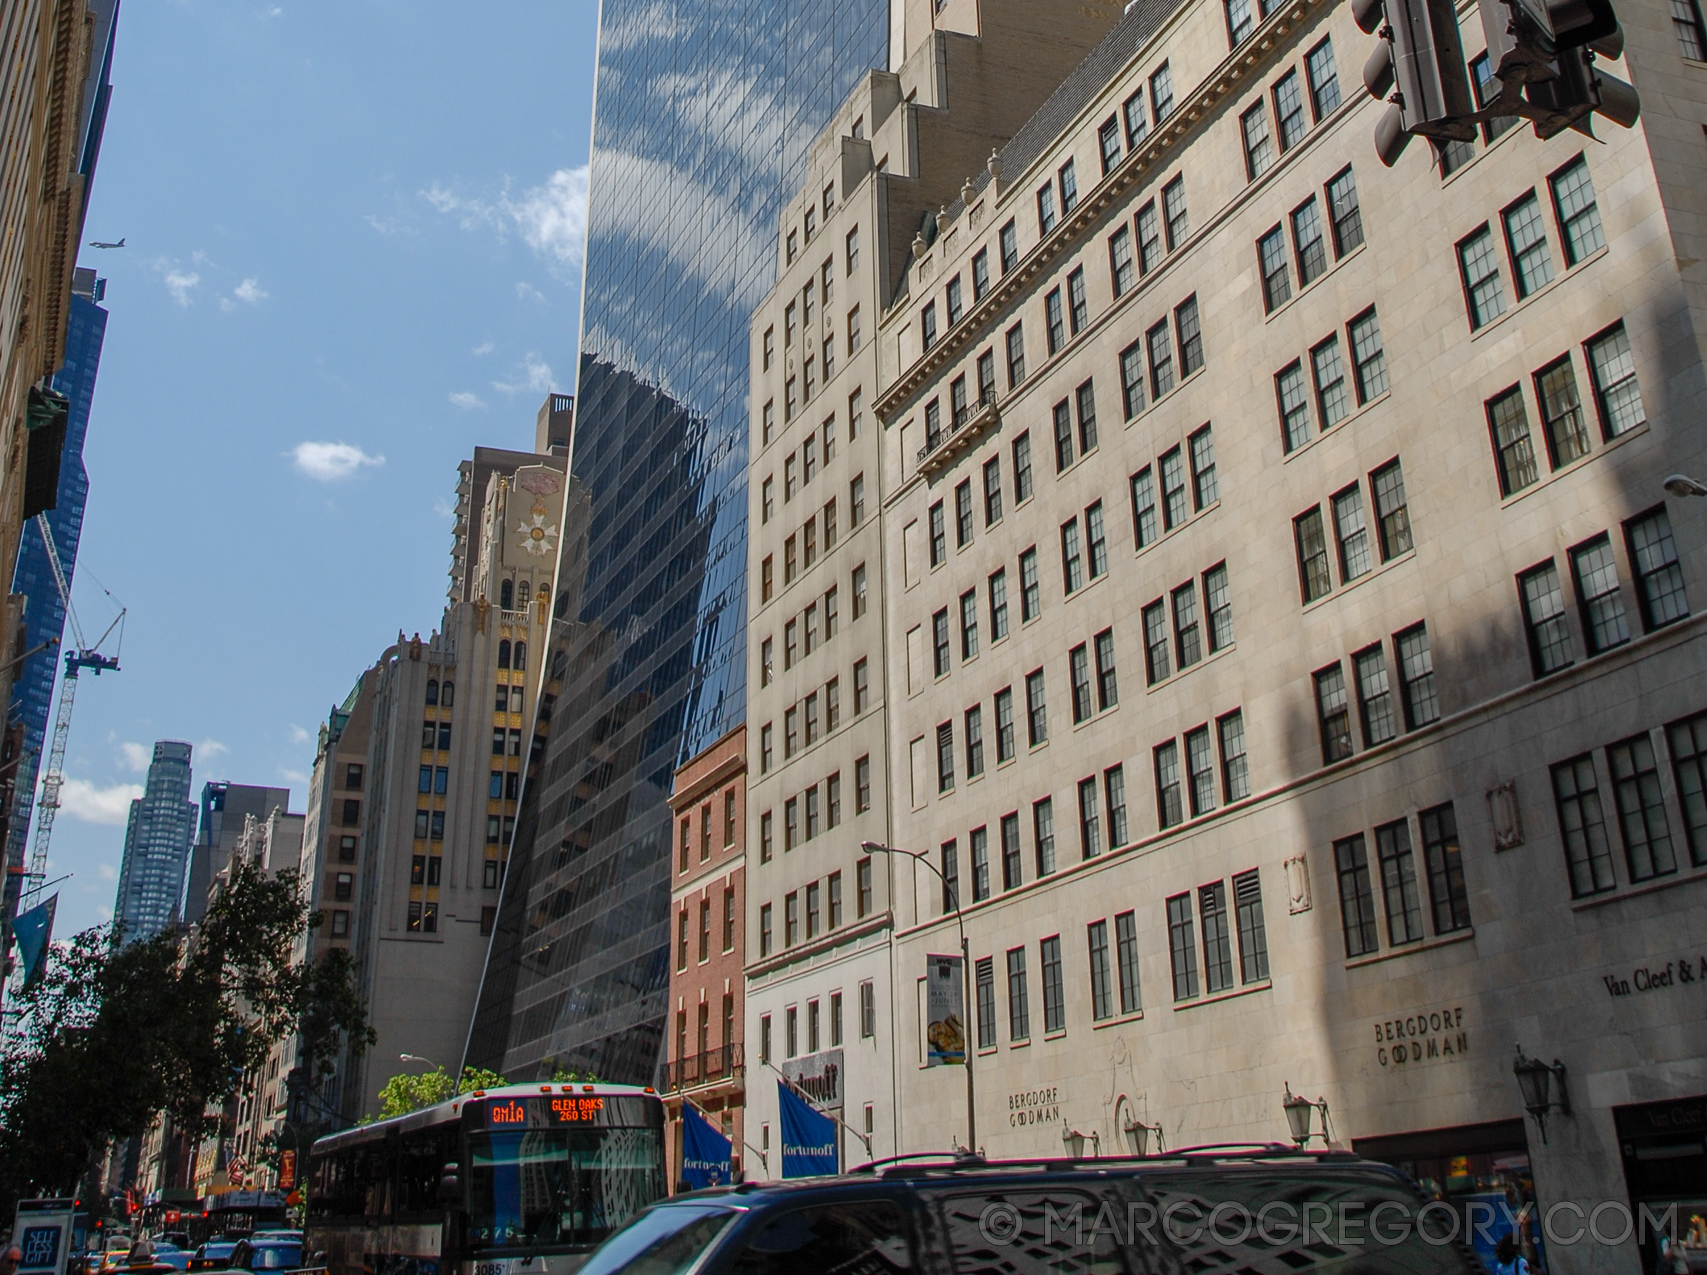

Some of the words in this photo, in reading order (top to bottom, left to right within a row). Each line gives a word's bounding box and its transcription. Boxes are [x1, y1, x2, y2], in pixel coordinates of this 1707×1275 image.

[1603, 975, 1631, 997] Van
[1634, 962, 1674, 991] Cleef
[1679, 959, 1695, 983] &
[1374, 1007, 1462, 1042] BERGDORF
[1378, 1032, 1468, 1066] GOODMAN
[552, 1099, 576, 1111] GLEN
[578, 1098, 604, 1111] OAKS
[1009, 1087, 1057, 1110] BERGDORF
[560, 1110, 578, 1121] 260
[581, 1110, 594, 1121] ST
[1010, 1106, 1059, 1127] GOODMAN
[783, 1142, 835, 1158] fortunoff
[30, 1230, 57, 1243] SELF
[28, 1241, 52, 1253] LESS
[25, 1251, 50, 1263] GIFT
